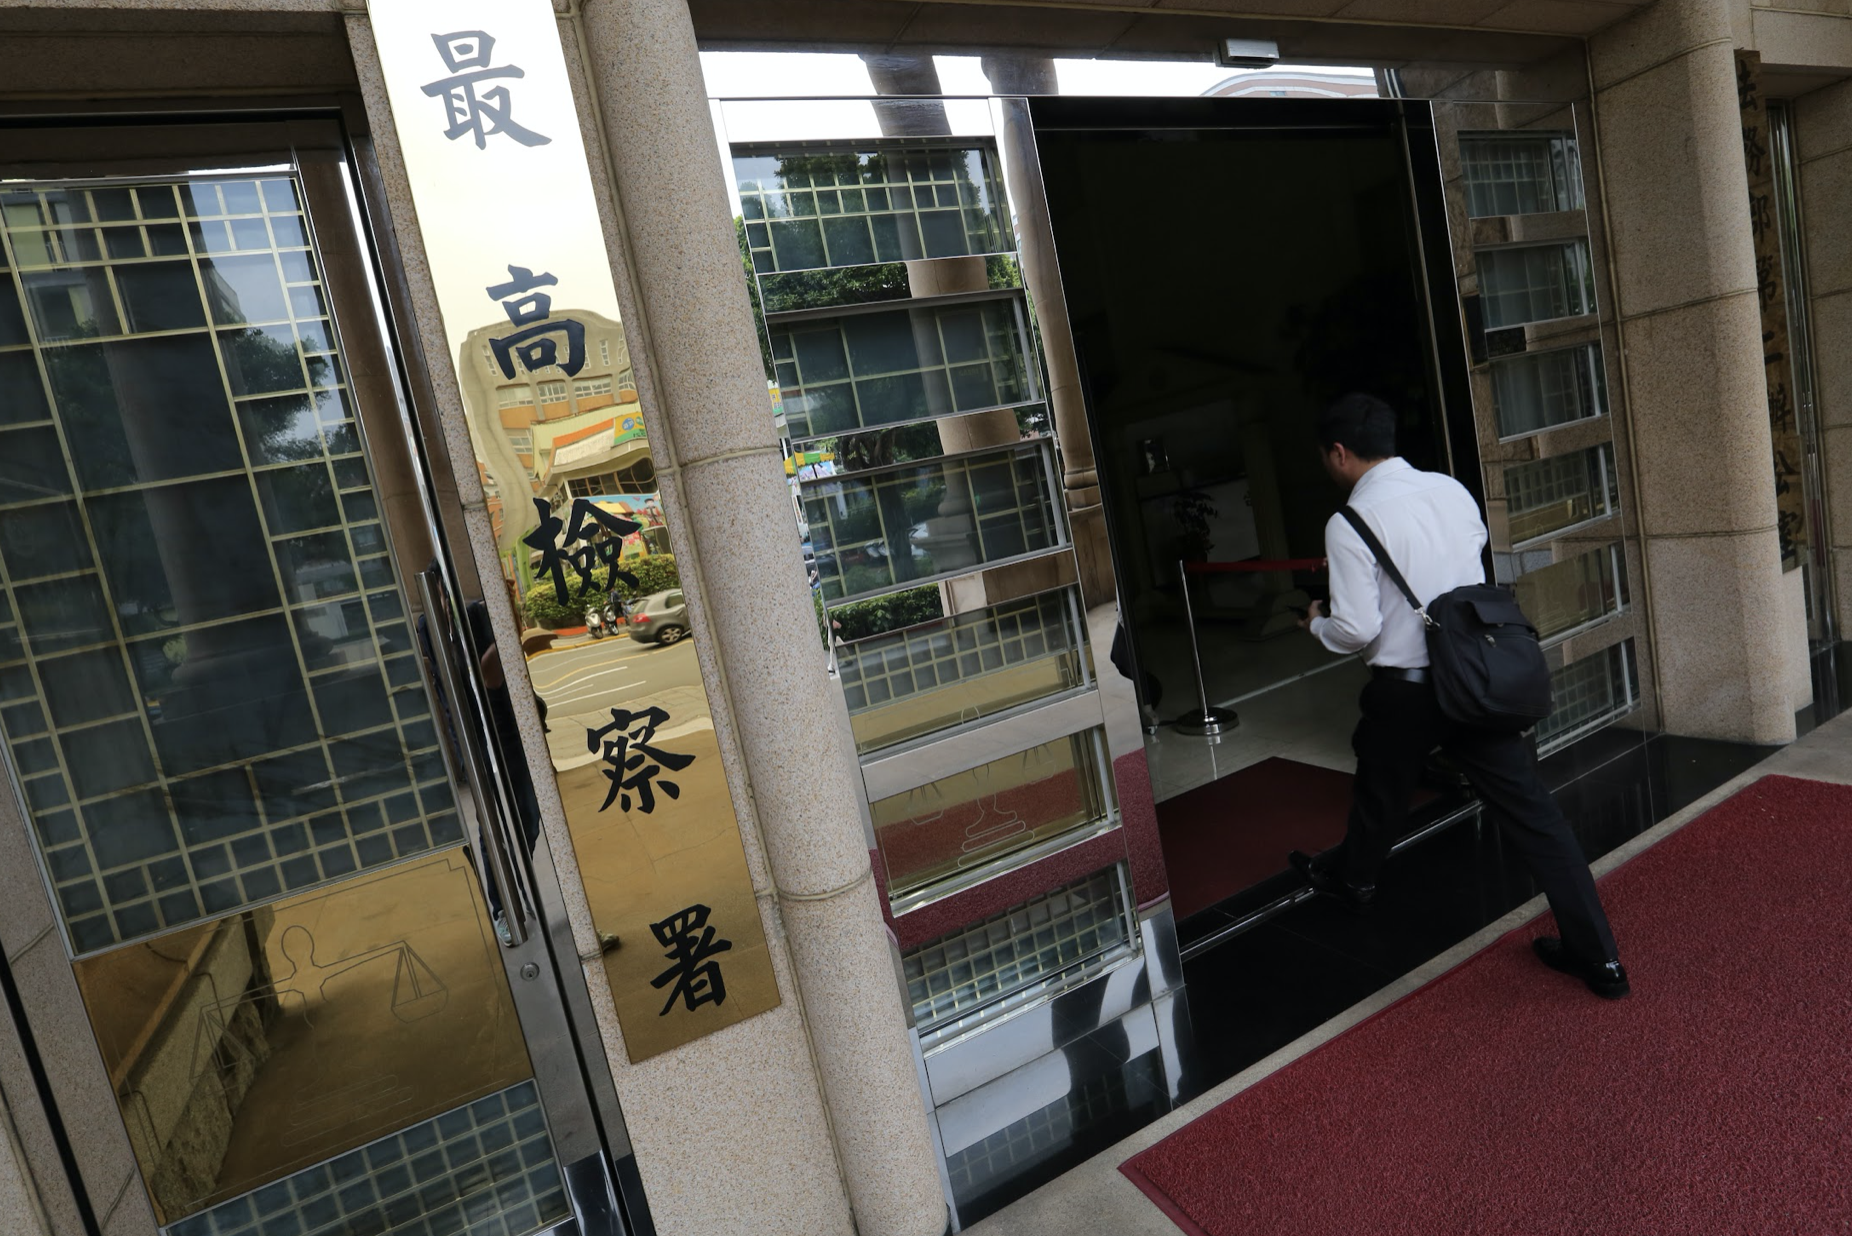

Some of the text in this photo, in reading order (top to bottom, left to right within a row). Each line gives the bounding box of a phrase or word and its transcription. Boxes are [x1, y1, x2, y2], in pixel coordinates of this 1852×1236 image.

[420, 30, 733, 1016] 最高檢察署
